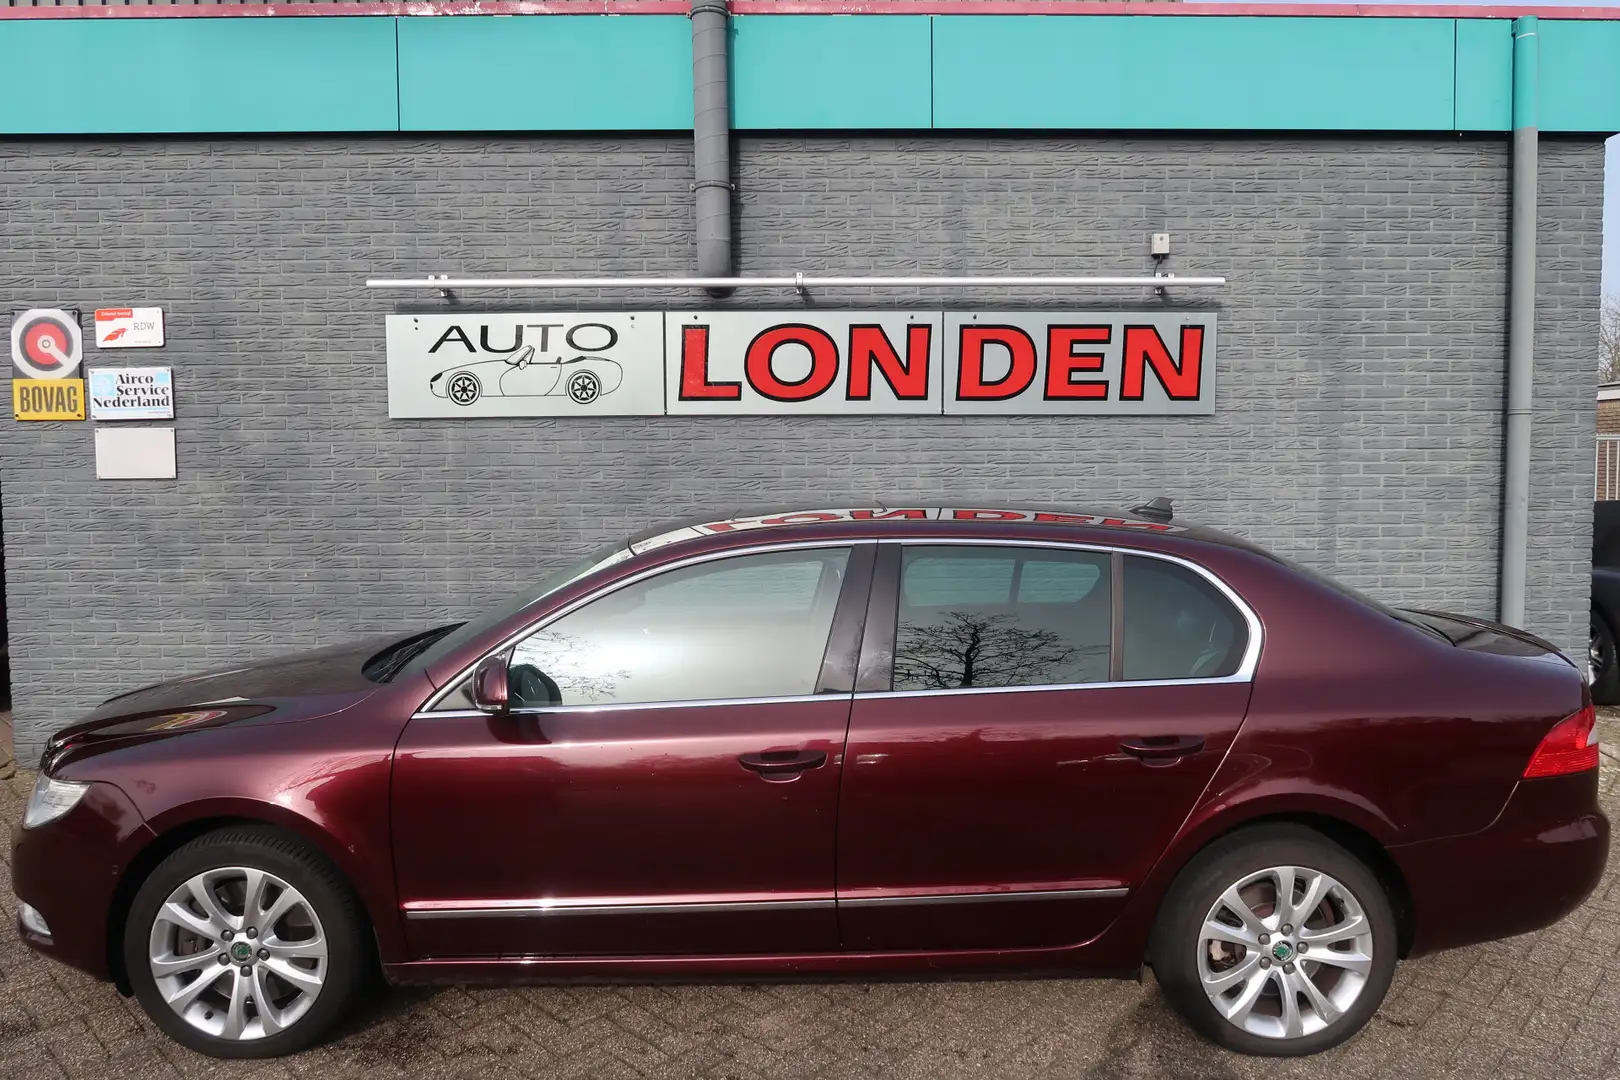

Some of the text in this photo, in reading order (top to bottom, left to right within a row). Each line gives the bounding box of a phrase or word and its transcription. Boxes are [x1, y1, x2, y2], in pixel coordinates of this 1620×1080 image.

[133, 321, 155, 331] RDW
[428, 323, 1205, 402] AUTO LONDEN
[115, 374, 154, 384] Airco
[116, 384, 169, 396] Service
[19, 386, 78, 412] BOVAG
[93, 396, 170, 408] Nederland
